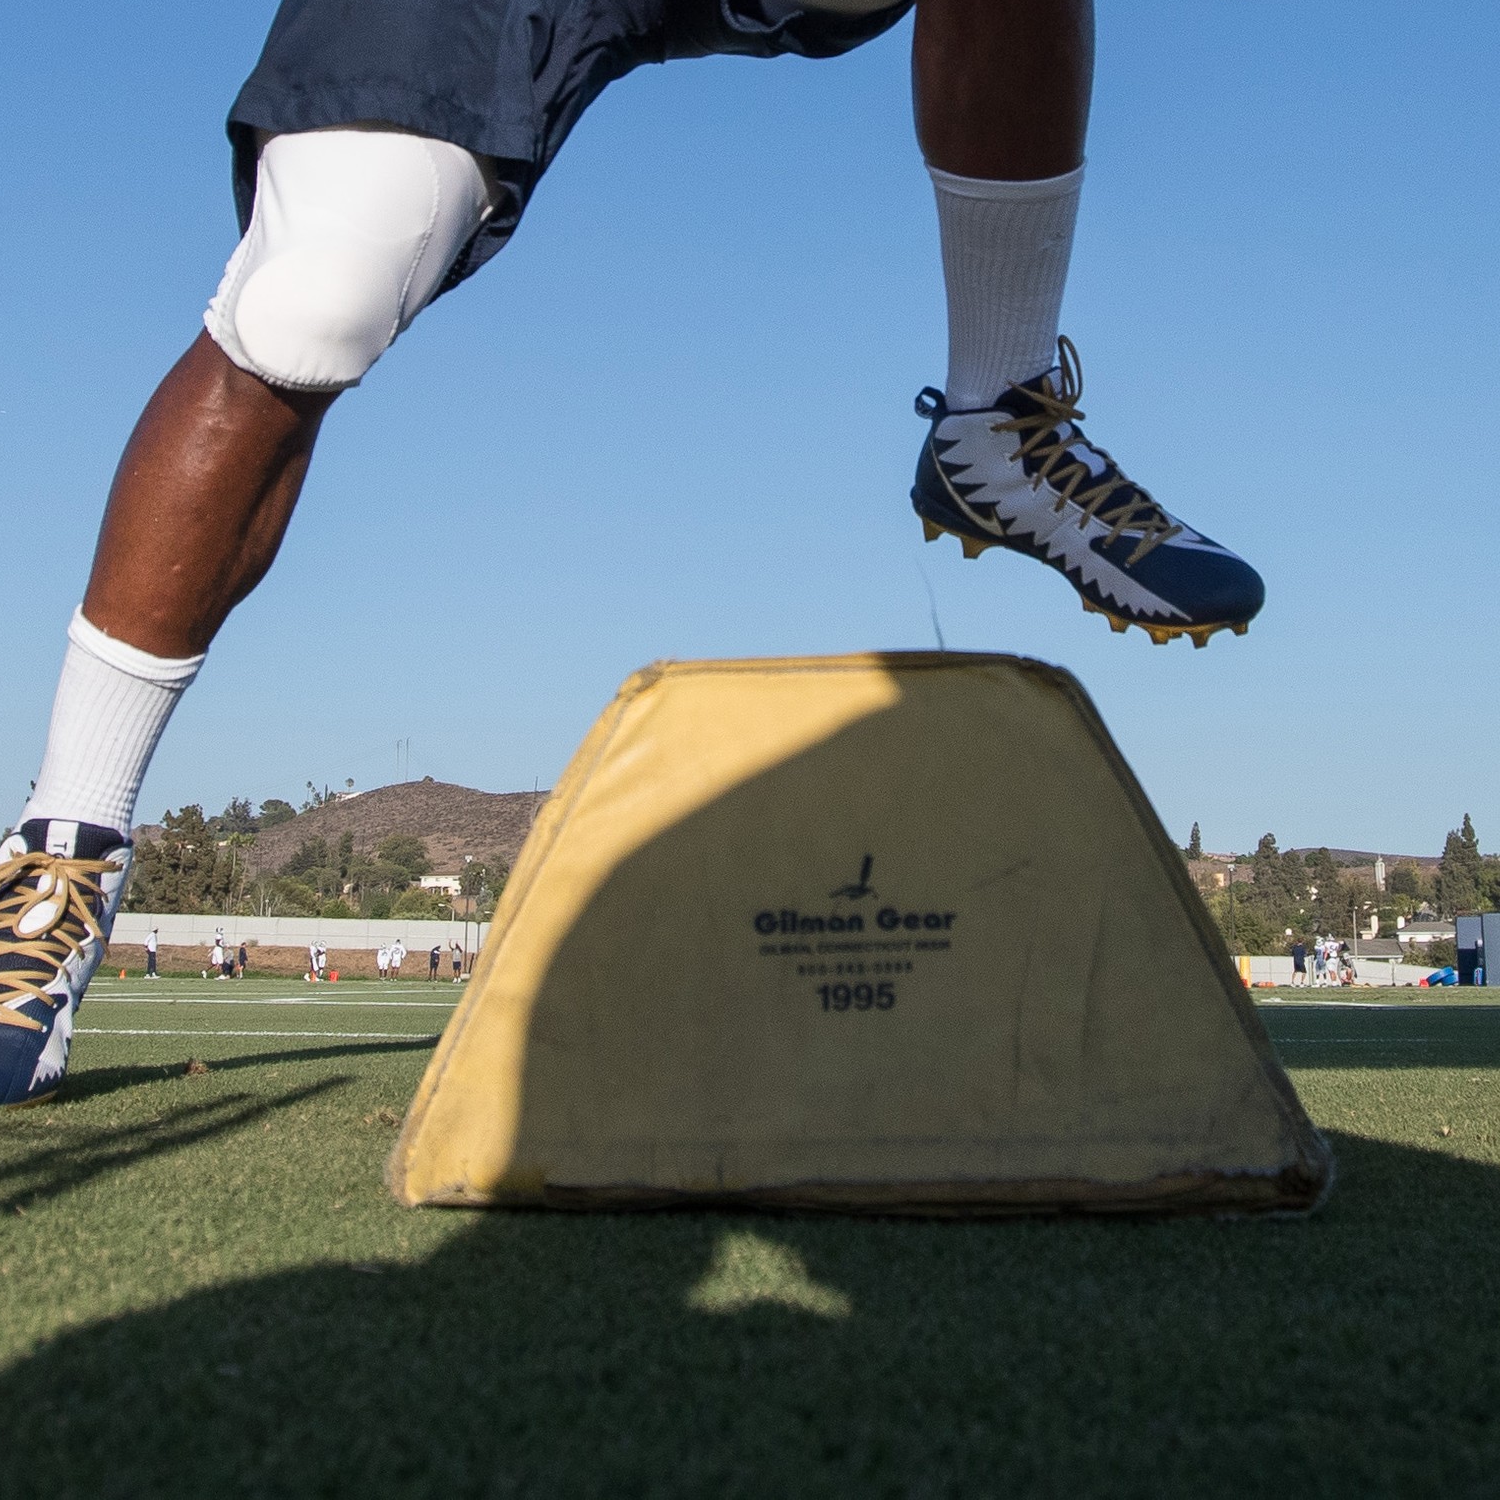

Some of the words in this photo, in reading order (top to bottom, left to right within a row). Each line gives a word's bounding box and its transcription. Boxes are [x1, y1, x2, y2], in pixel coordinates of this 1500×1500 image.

[754, 910, 865, 934] Gilman
[876, 907, 957, 931] Gear
[817, 981, 896, 1013] 1995
